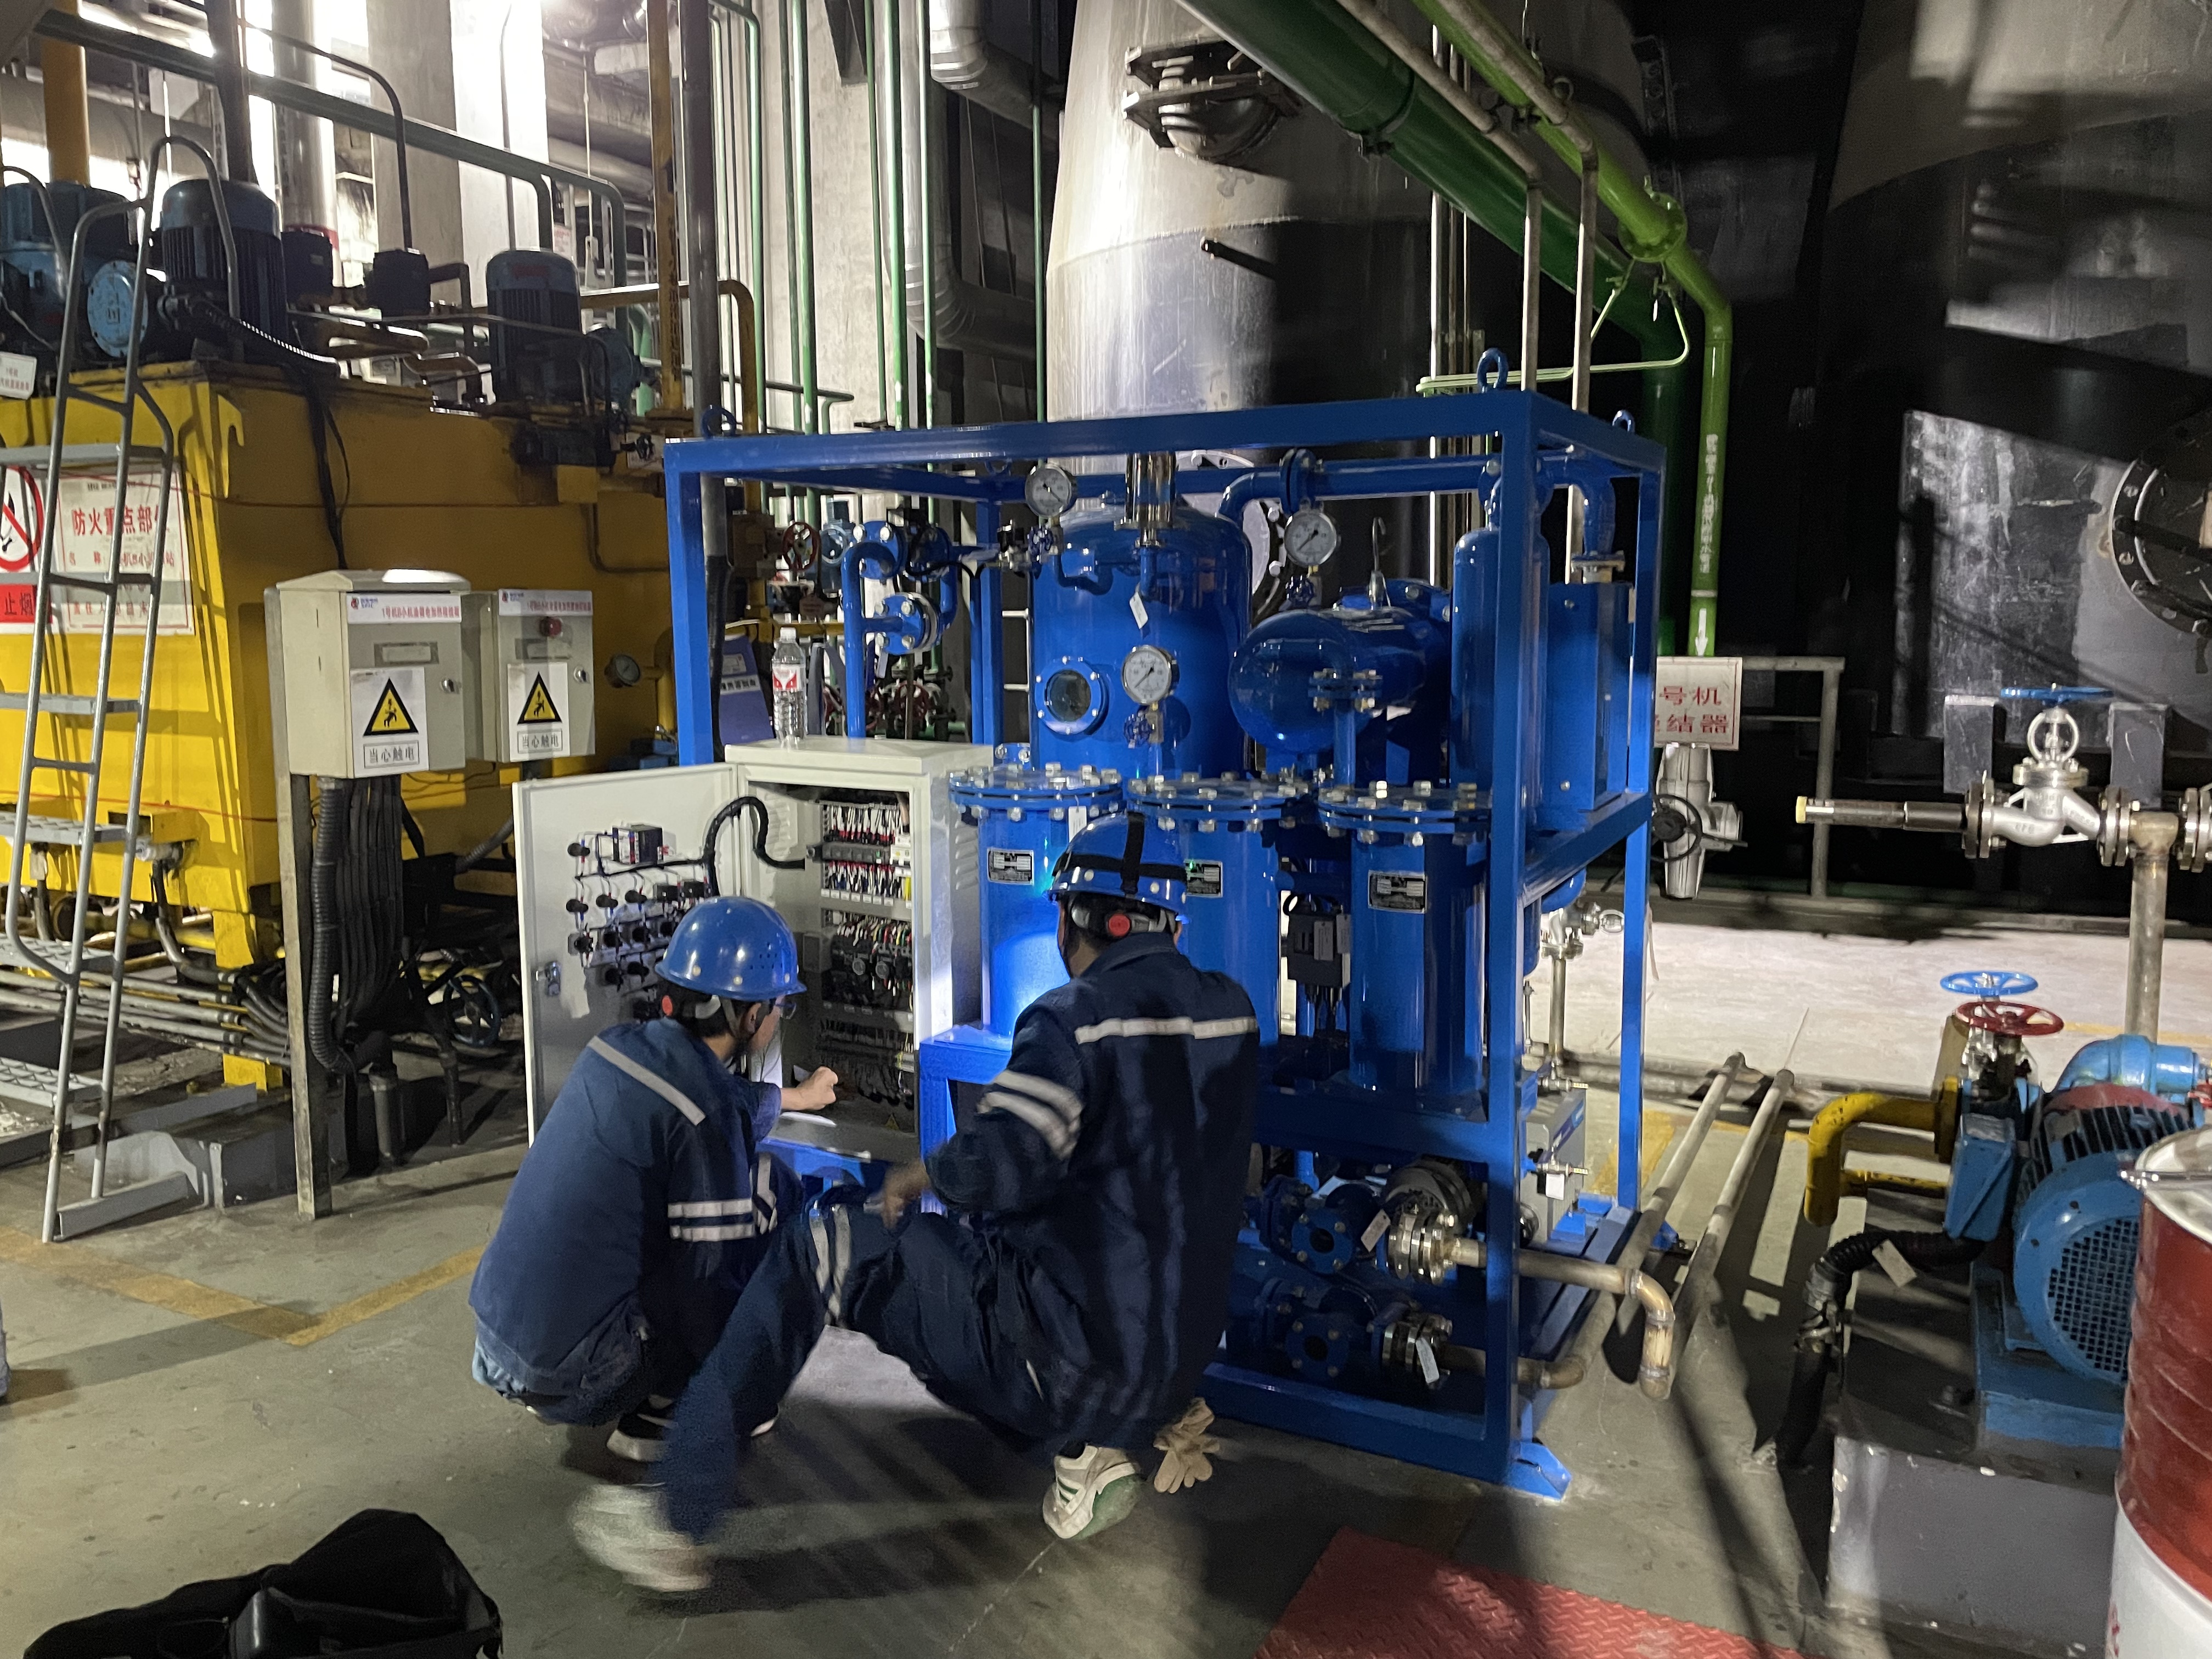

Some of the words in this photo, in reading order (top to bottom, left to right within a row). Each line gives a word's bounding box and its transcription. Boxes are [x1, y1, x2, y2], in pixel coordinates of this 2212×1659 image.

[1655, 712, 1728, 733] 结器
[522, 733, 559, 748] 当心触电
[369, 746, 415, 764] 当心触电
